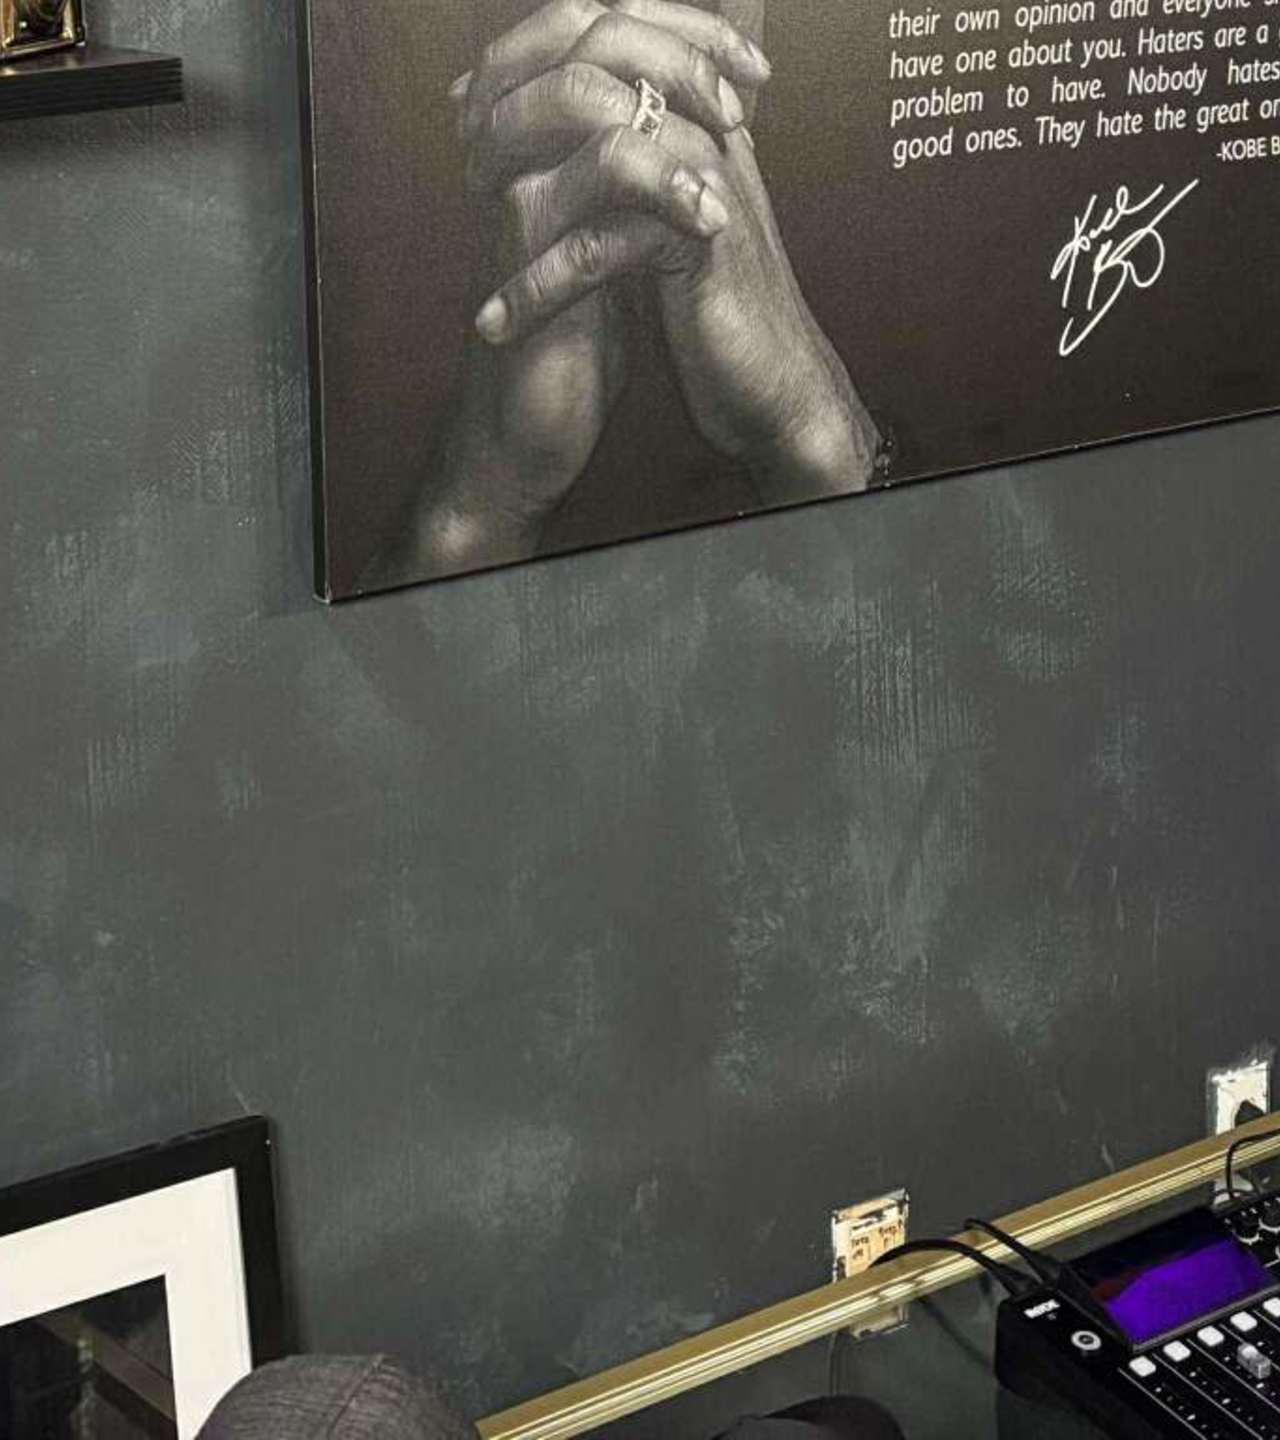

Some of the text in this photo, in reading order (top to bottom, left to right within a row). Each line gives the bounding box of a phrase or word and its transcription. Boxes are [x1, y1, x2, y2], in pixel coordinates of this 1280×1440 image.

[888, 8, 941, 39] their
[954, 8, 1000, 33] own
[889, 50, 944, 80] have
[955, 49, 997, 74] one
[1008, 38, 1073, 69] about
[1079, 37, 1127, 69] you.
[1137, 27, 1204, 56] Haters
[1213, 26, 1247, 49] are
[1255, 24, 1269, 45] a
[890, 85, 984, 129] problem
[1006, 83, 1030, 109] to
[1051, 75, 1106, 104] have.
[1127, 61, 1208, 96] Nobody
[892, 126, 954, 170] good
[965, 127, 1023, 153] ones.
[1034, 115, 1086, 149] They
[1096, 109, 1144, 139] hate
[1154, 103, 1187, 132] the
[1196, 98, 1250, 134] great
[1215, 136, 1268, 162] -KOBE
